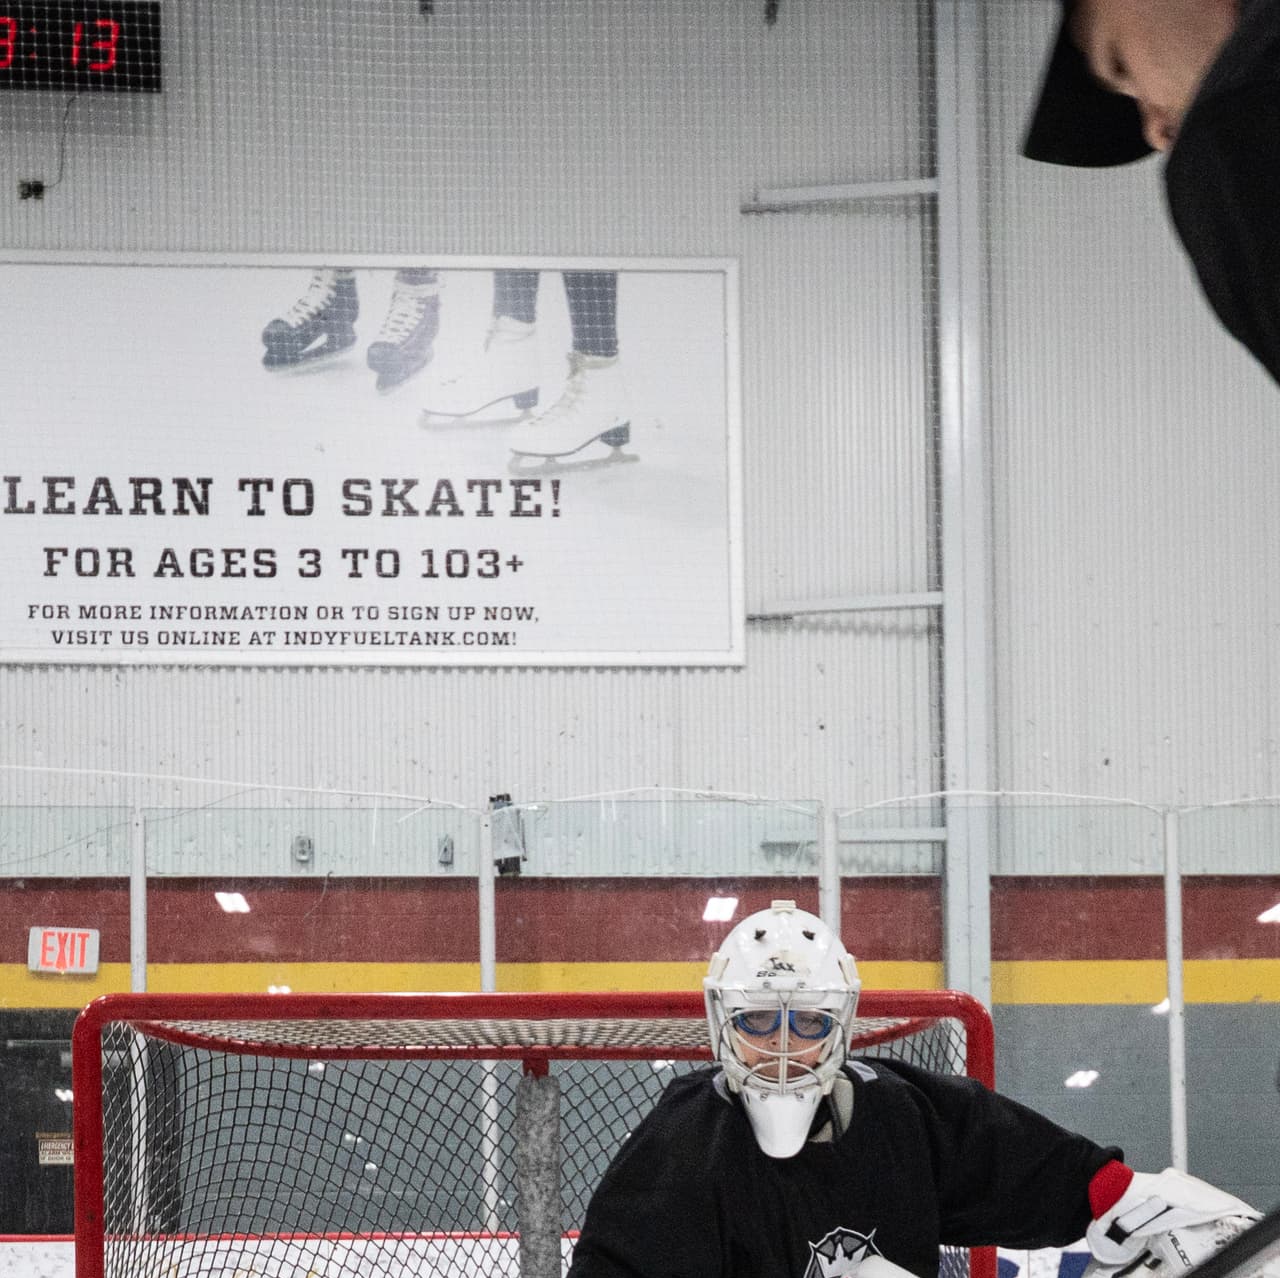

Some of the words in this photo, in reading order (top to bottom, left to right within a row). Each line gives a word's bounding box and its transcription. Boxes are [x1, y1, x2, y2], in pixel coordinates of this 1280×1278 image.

[3, 475, 213, 516] LEARN
[239, 476, 315, 517] TO
[342, 477, 562, 518] SKATE!
[43, 547, 135, 578] FOR
[154, 547, 278, 578] AGES
[297, 548, 323, 579] 3
[342, 548, 401, 579] TO
[420, 548, 525, 579] 103+
[27, 603, 71, 620] FOR
[78, 603, 142, 620] MORE
[149, 604, 309, 621] INFORMATION
[316, 605, 344, 621] OR
[352, 605, 380, 621] TO
[387, 605, 440, 621] SIGN
[447, 605, 477, 622] UP
[483, 605, 541, 624] NOW,
[51, 628, 113, 646] VISIT
[120, 629, 150, 646] US
[157, 629, 242, 646] ONLINE
[249, 629, 277, 646] AT
[283, 629, 519, 647] INDYFUELTANK.COM!
[40, 930, 90, 969] EXIT
